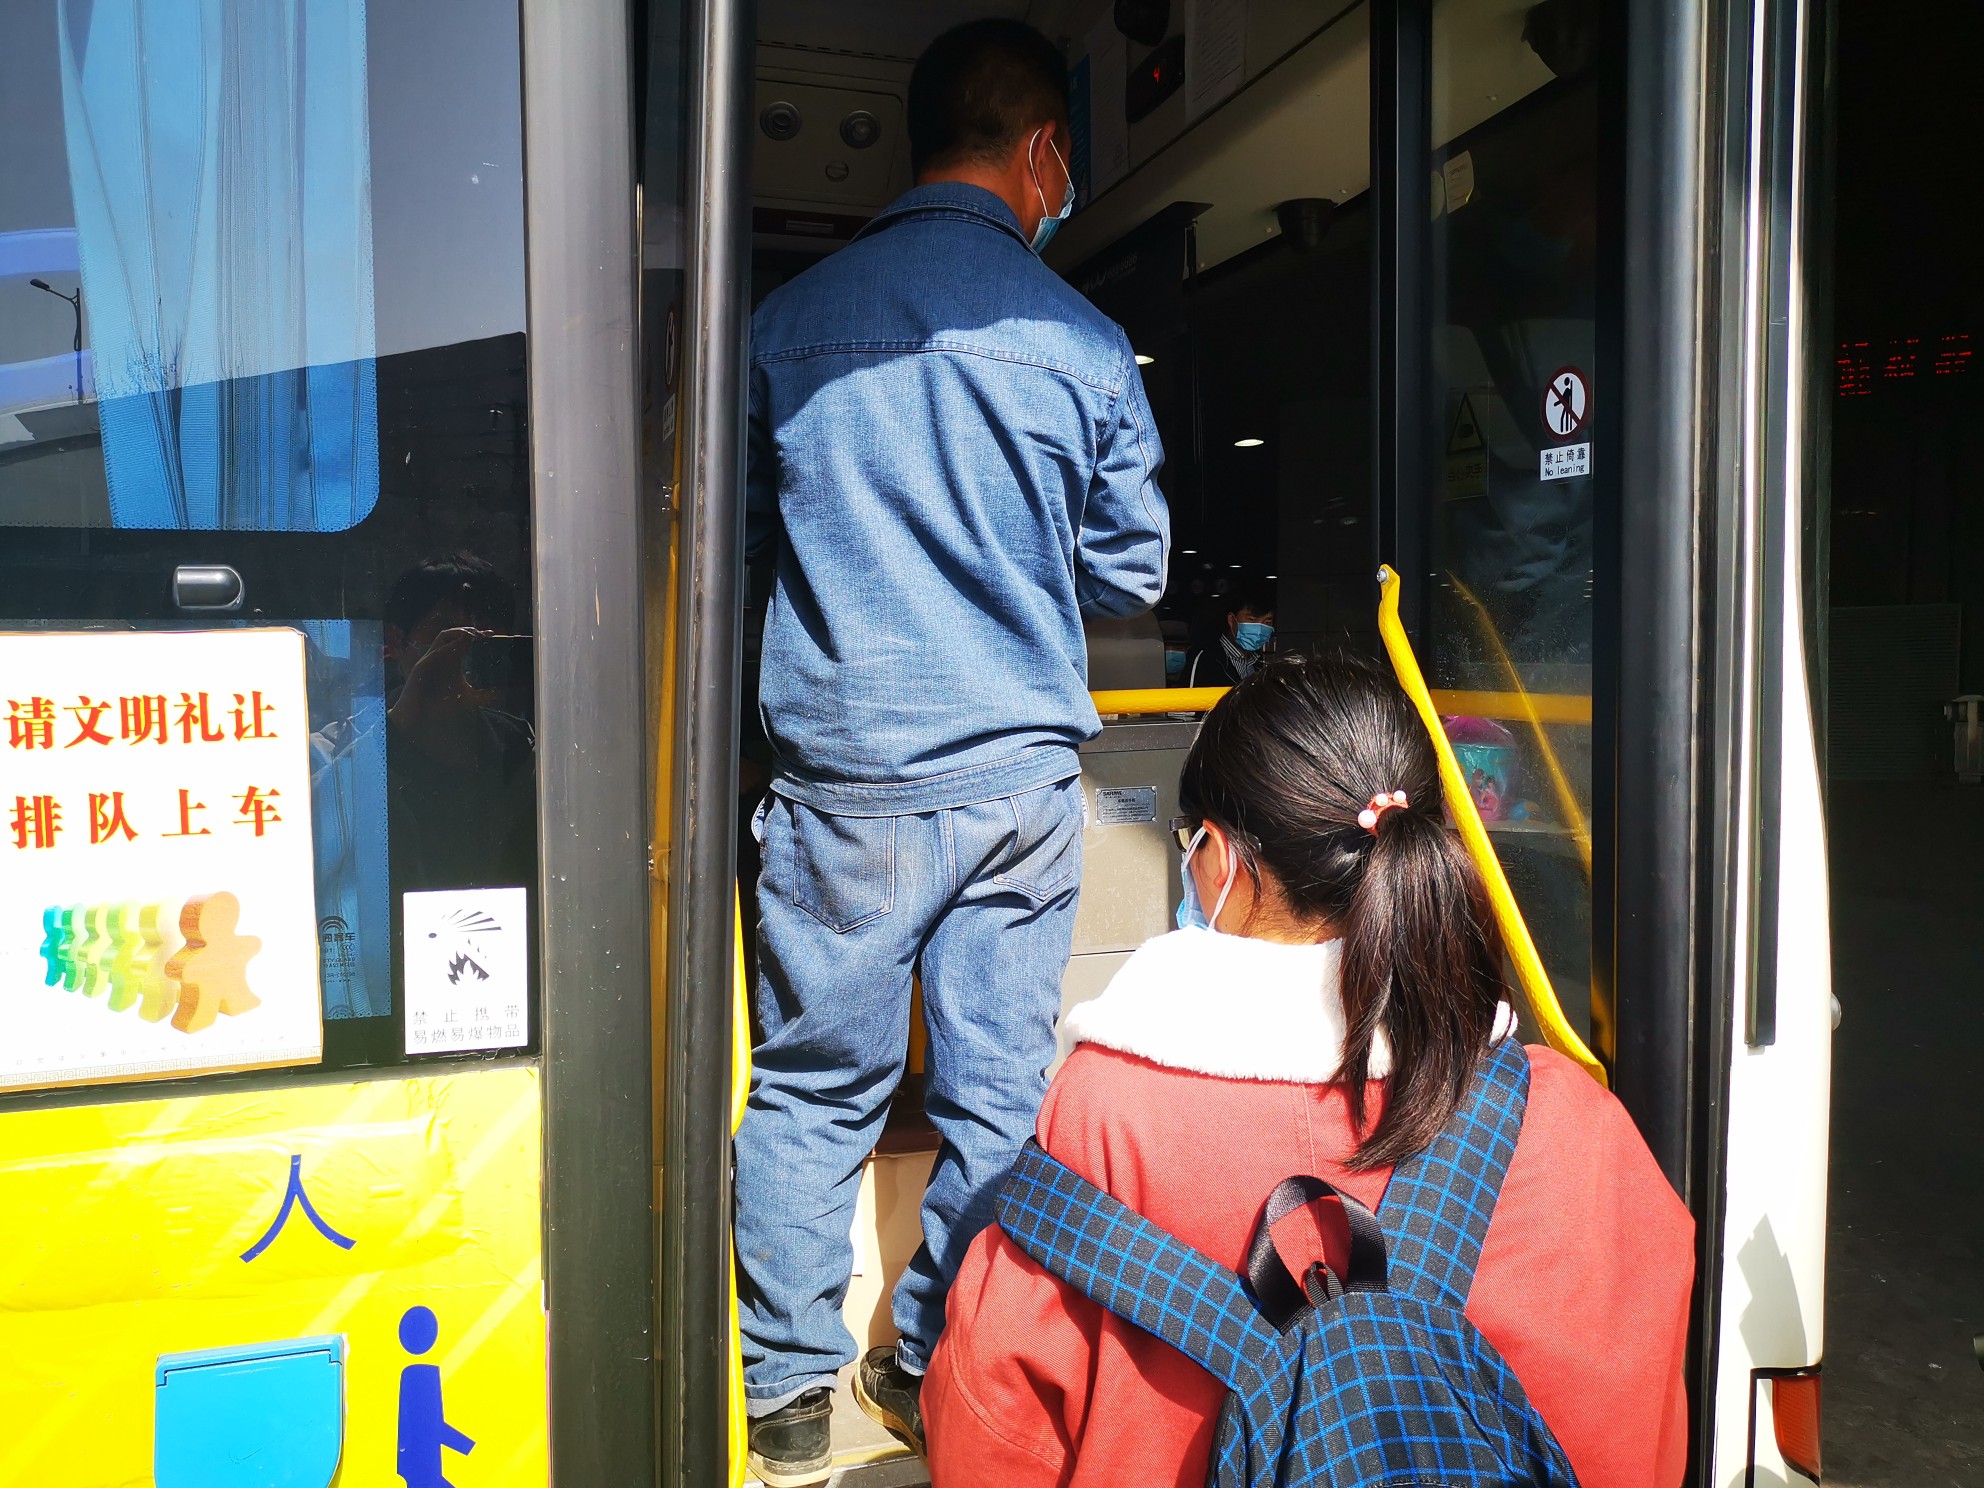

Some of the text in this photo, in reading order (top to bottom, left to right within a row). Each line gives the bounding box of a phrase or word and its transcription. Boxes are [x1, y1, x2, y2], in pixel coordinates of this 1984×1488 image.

[1544, 447, 1586, 466] 禁止倚靠
[1545, 464, 1585, 477] No leaning
[3, 691, 279, 750] 请文明礼让
[9, 786, 283, 849] 排队上车
[413, 1004, 520, 1025] 禁止携带
[413, 1023, 520, 1044] 易燃易爆物品
